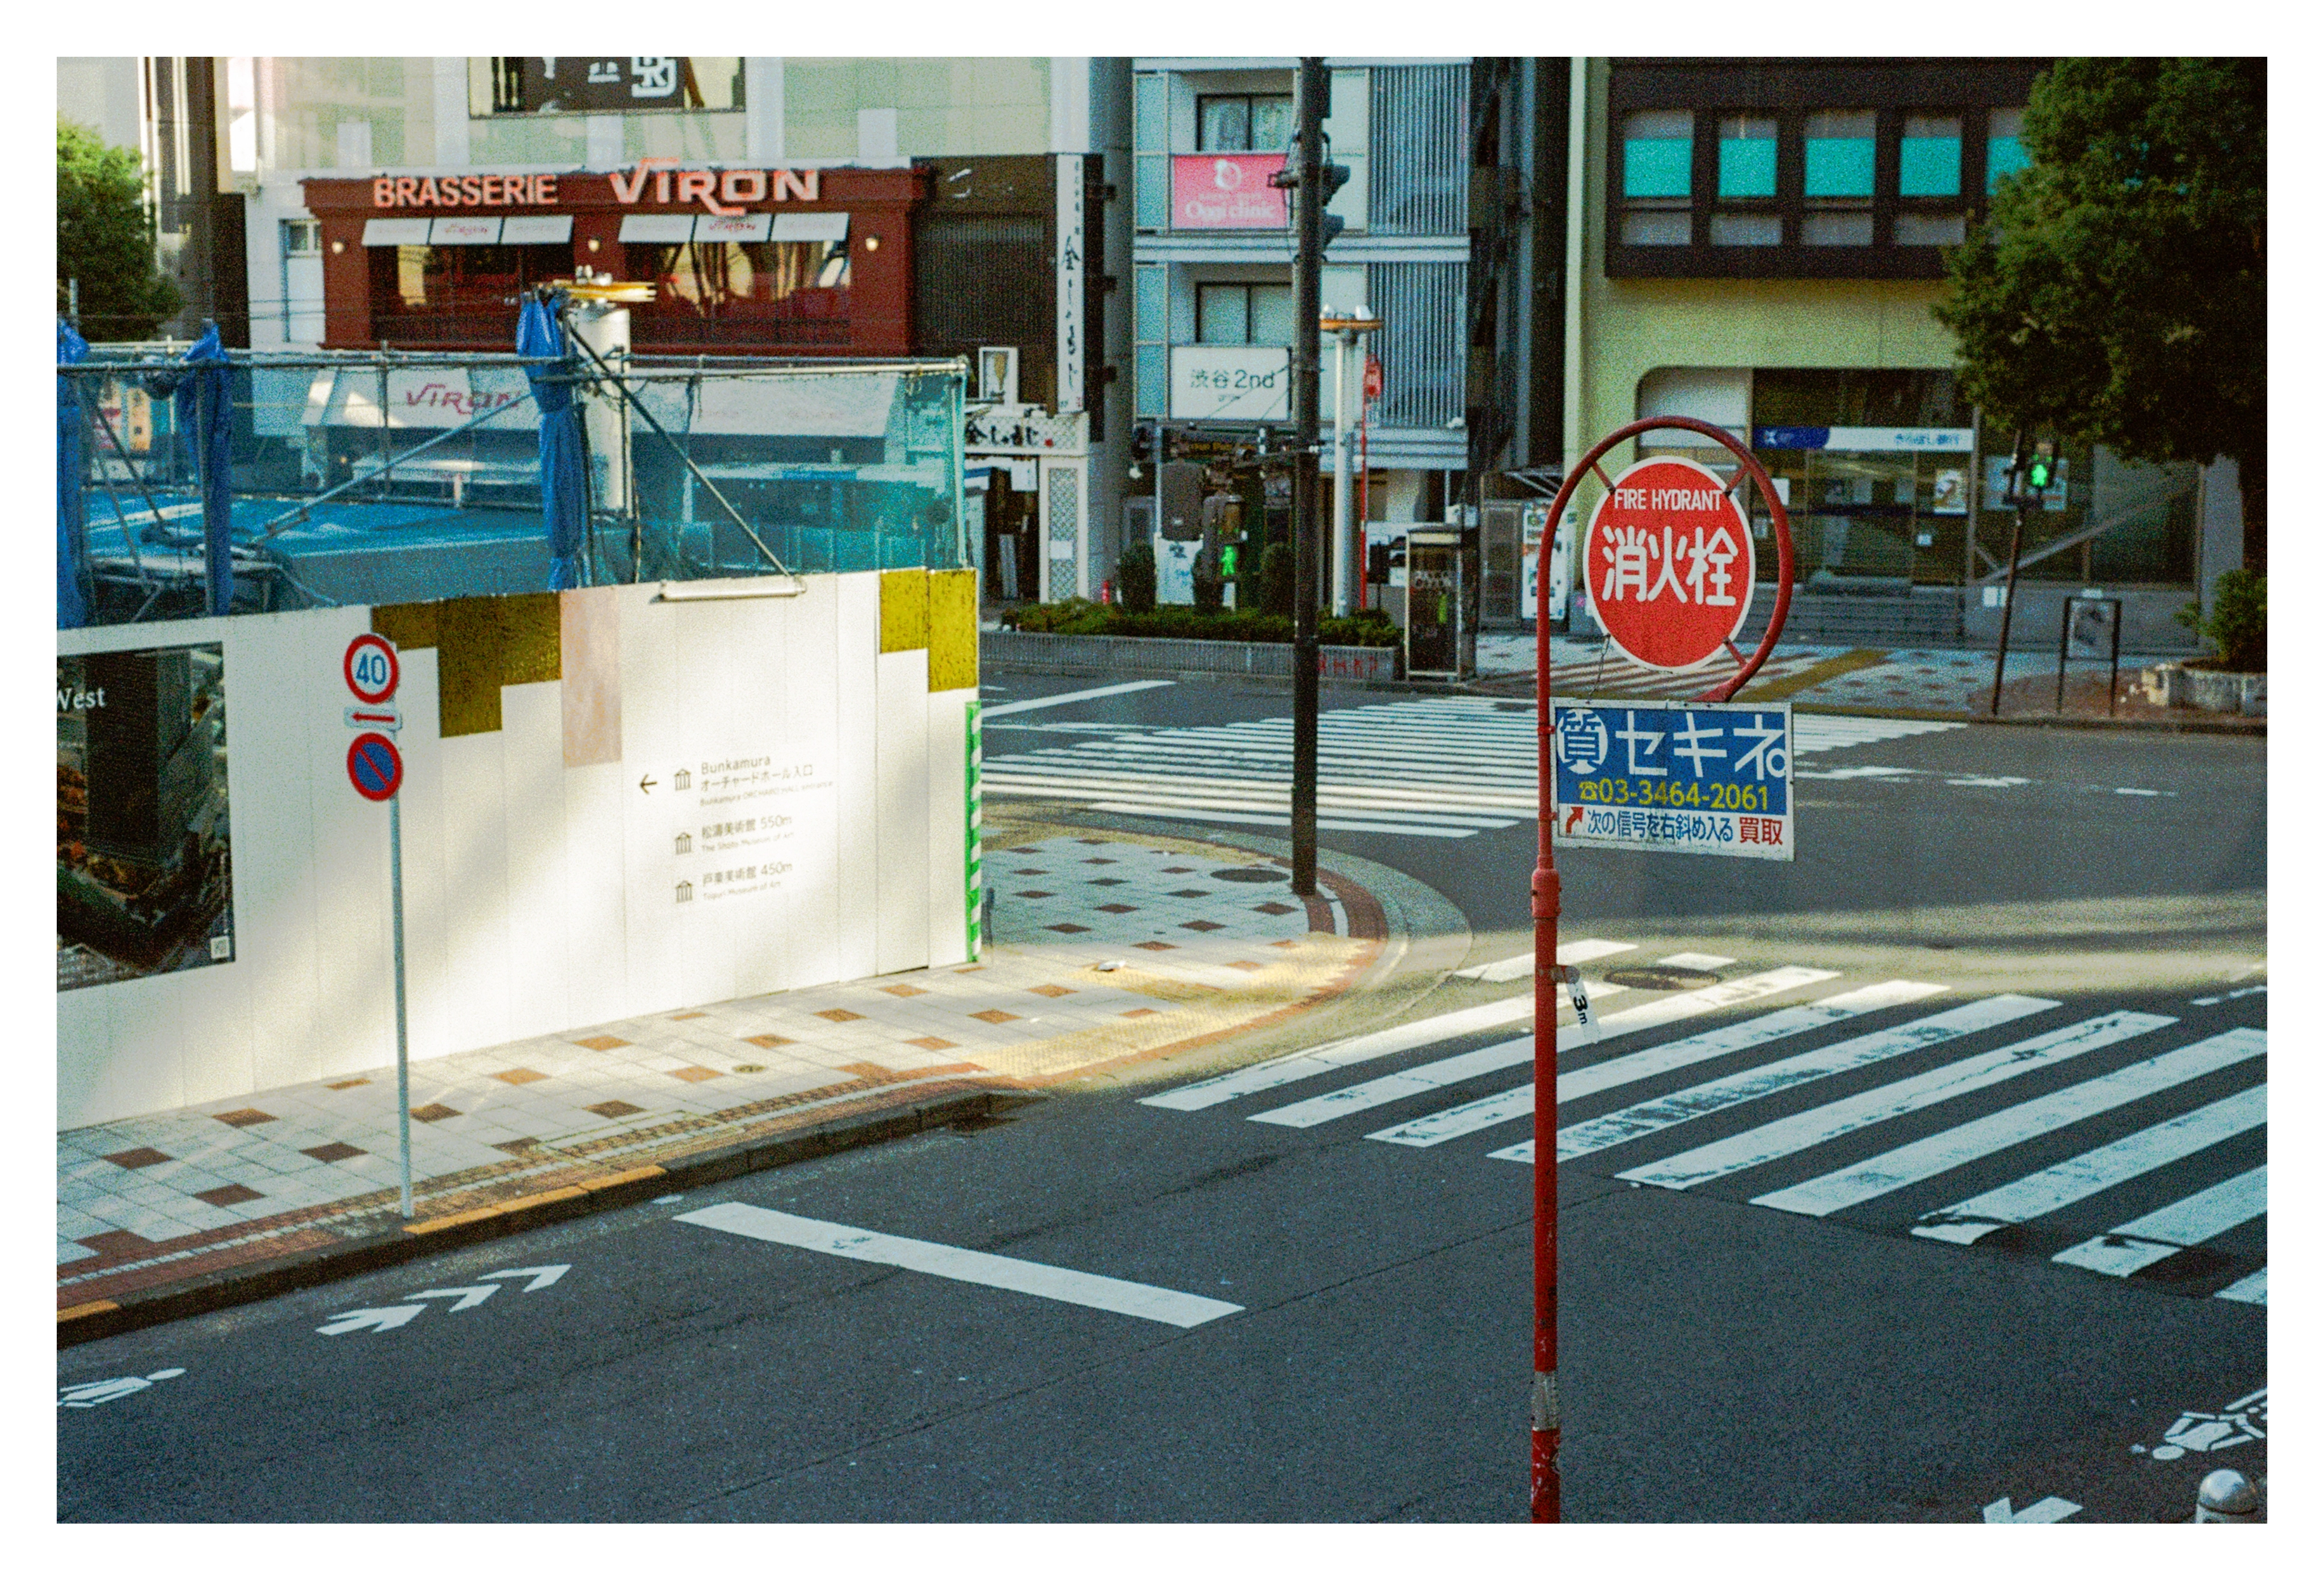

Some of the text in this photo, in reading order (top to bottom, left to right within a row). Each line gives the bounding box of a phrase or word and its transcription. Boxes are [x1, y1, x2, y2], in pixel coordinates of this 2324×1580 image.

[373, 157, 820, 216] BRASSERIE VIRON
[1614, 489, 1722, 511] FIRE HYDRANT
[1602, 526, 1738, 606] 消火栓
[355, 653, 386, 686] 40
[1557, 709, 1608, 774] 質
[701, 756, 771, 775] Bunkamura
[1598, 778, 1767, 810] 03-3464-2061
[760, 814, 793, 830] 550m
[1588, 810, 1783, 846] 次の信号を右斜め入る 買取
[760, 861, 793, 875] 450m
